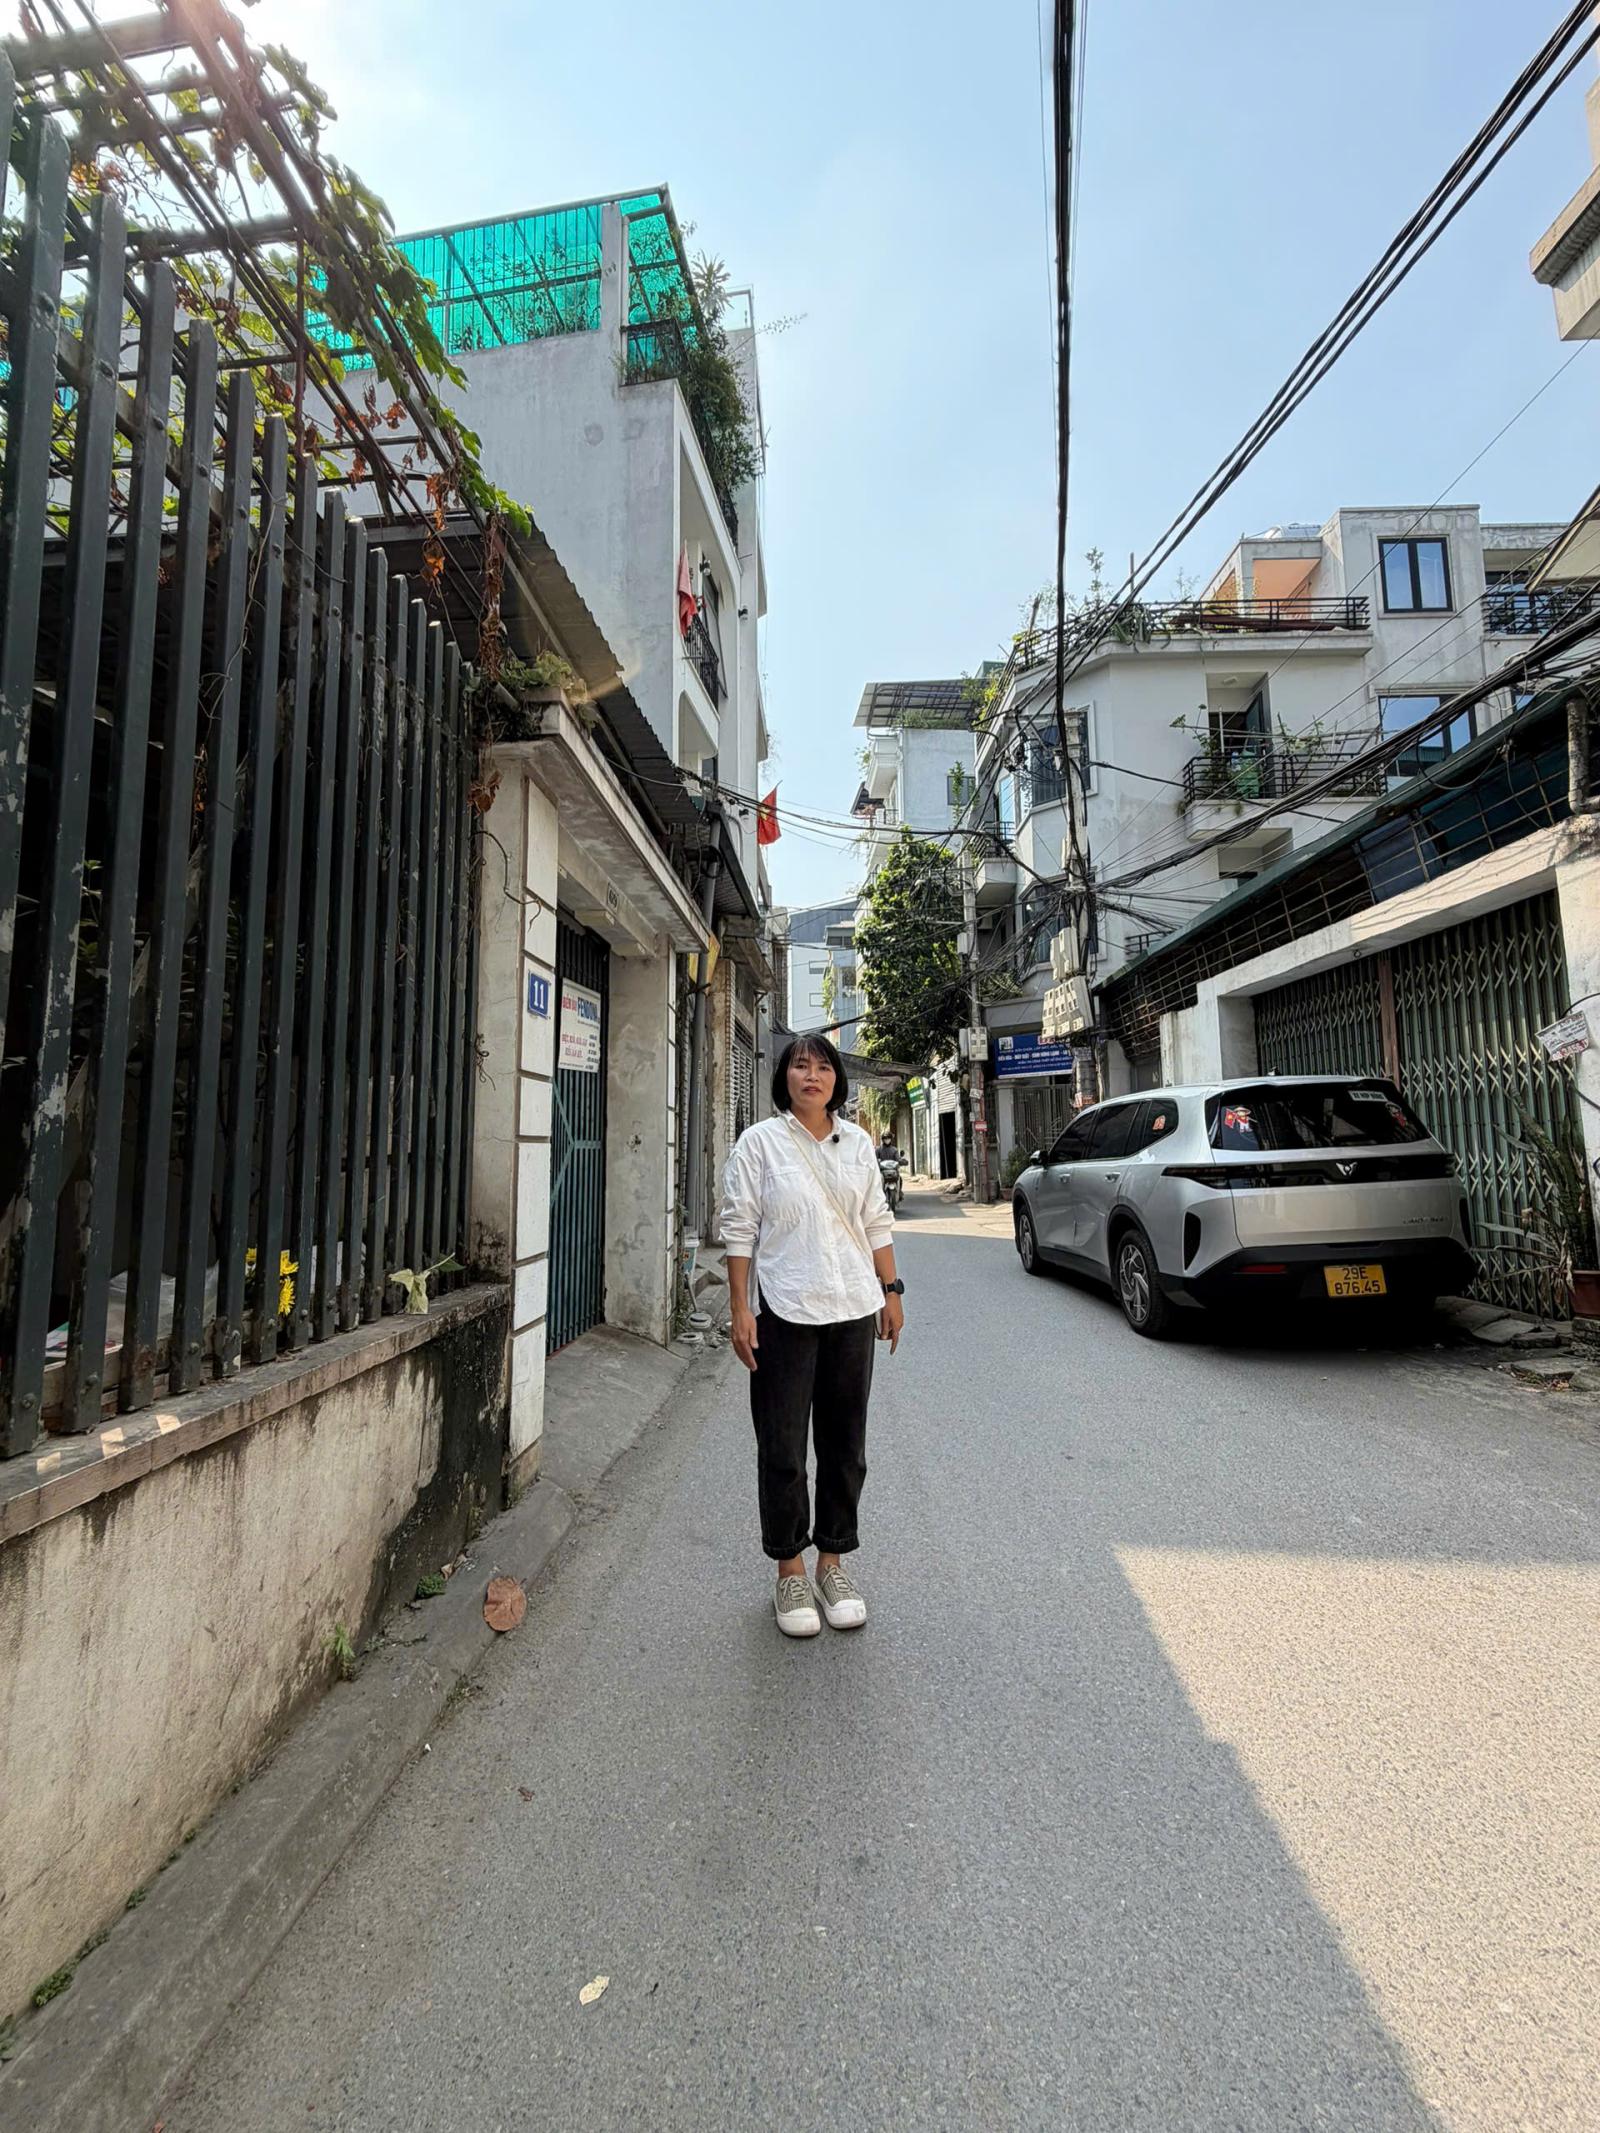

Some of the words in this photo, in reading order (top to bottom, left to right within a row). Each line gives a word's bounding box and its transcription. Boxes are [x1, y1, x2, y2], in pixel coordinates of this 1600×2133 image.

[533, 980, 545, 1009] 11
[1342, 1266, 1368, 1280] 29E
[1334, 1280, 1381, 1295] 876.45
